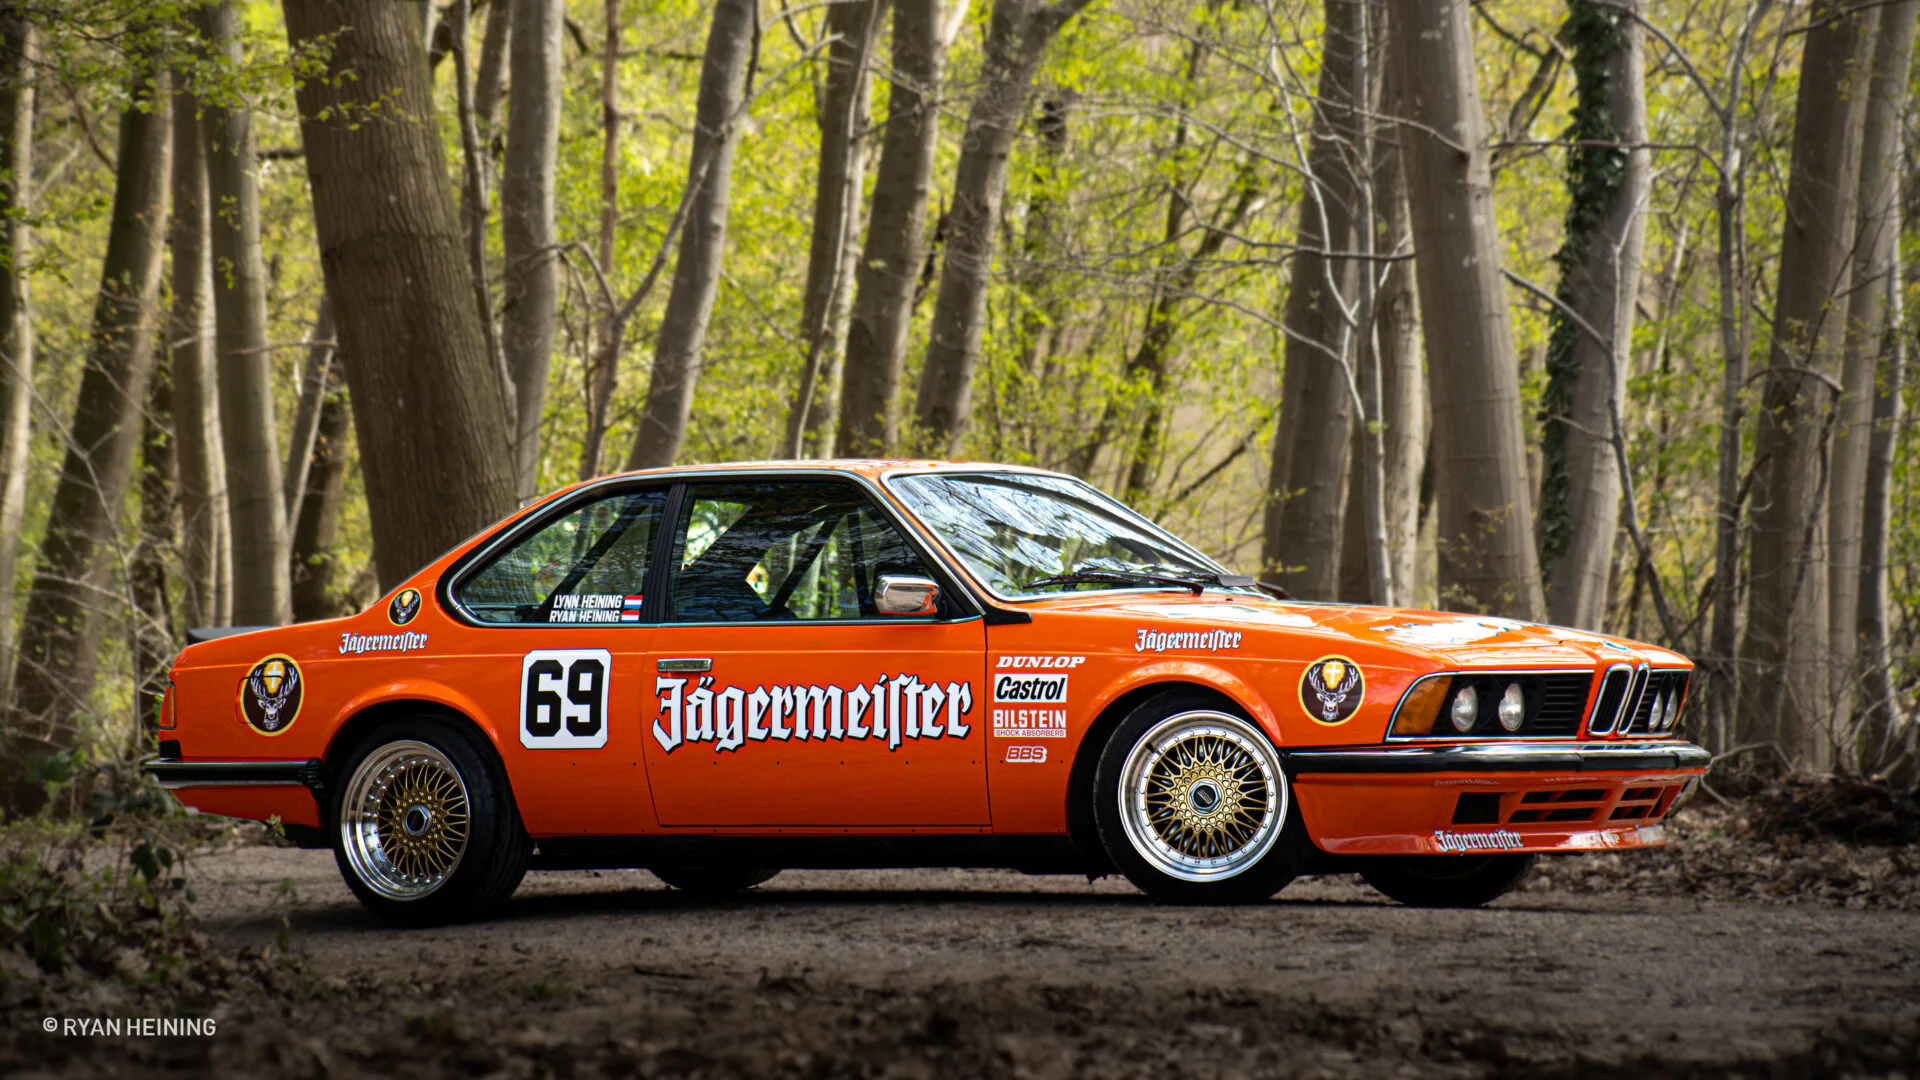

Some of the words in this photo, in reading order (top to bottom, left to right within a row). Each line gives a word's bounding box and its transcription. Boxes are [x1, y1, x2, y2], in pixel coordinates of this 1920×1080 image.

[553, 594, 580, 609] LYNN
[581, 594, 623, 609] HEINING
[549, 609, 577, 623] RYAN
[579, 609, 620, 623] HEINING
[996, 656, 1086, 668] DUNLOP
[996, 676, 1066, 701] Castrol
[525, 658, 605, 738] 69
[993, 709, 1067, 729] BILSTEIN
[995, 729, 1020, 737] SHOCK
[1021, 729, 1065, 737] ABSORBERS
[1007, 746, 1046, 761] BBS
